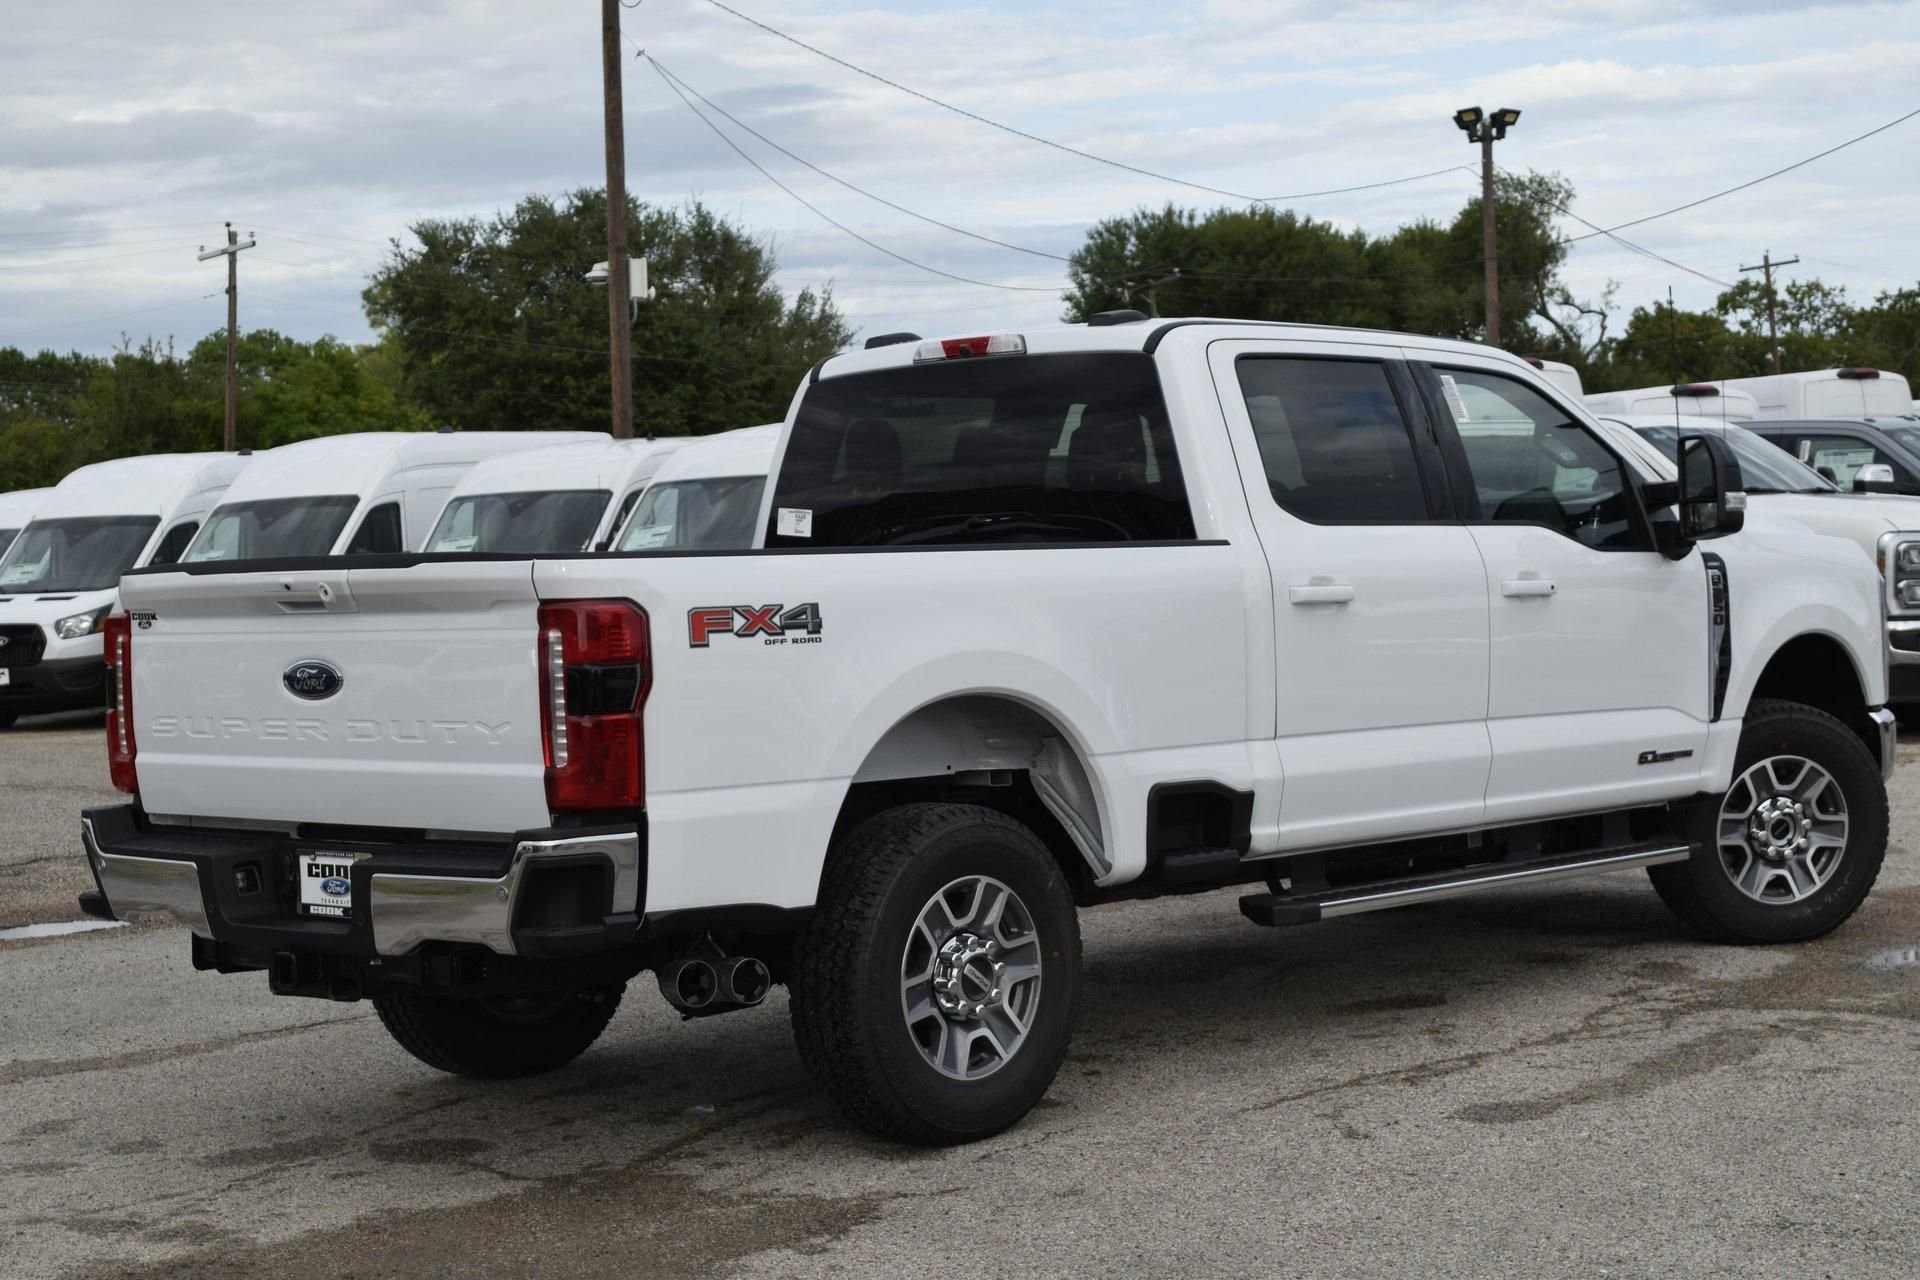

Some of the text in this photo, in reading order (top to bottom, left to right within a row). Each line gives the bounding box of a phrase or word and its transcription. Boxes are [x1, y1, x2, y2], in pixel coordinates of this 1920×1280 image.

[687, 602, 823, 648] FX4
[764, 637, 823, 646] OFF ROAD
[151, 715, 512, 745] SUPER DUTY
[307, 863, 351, 880] COO
[309, 905, 344, 916] COOK
